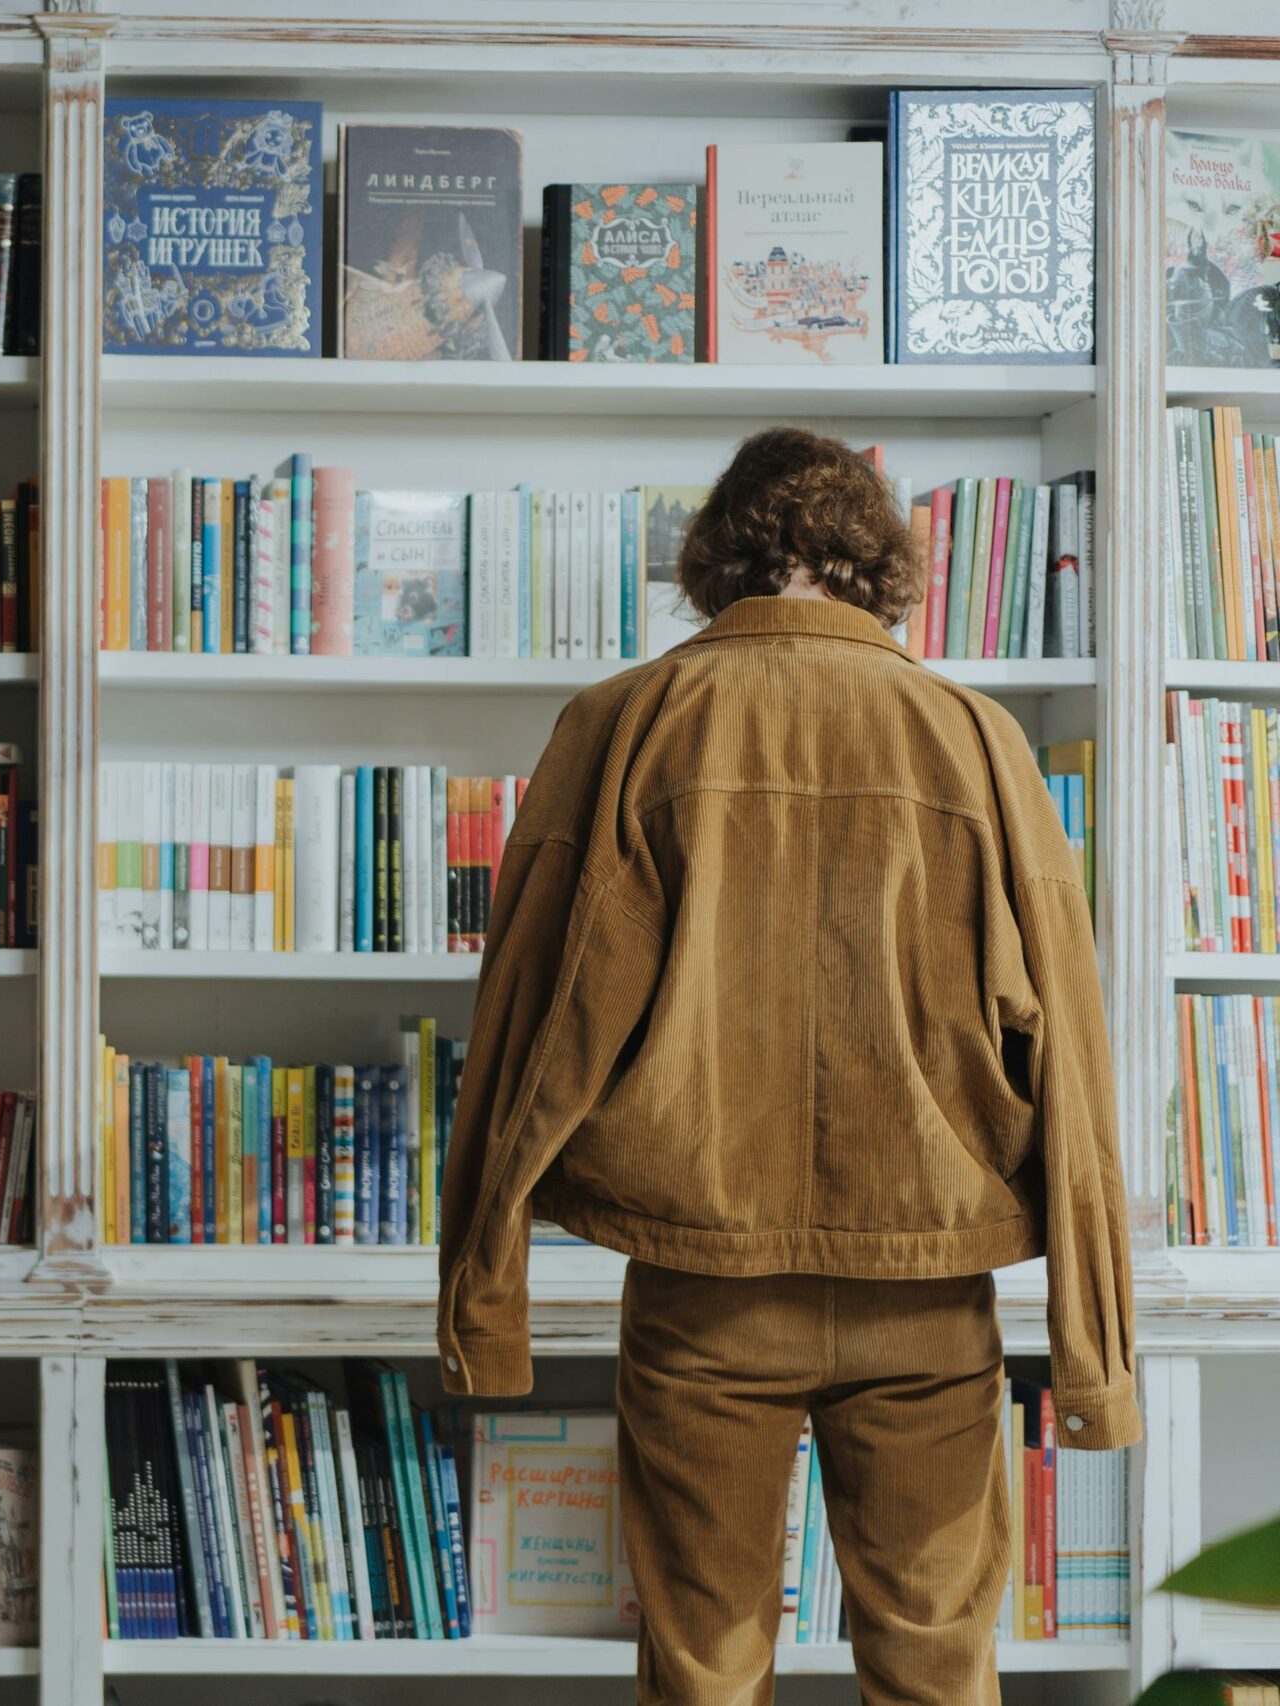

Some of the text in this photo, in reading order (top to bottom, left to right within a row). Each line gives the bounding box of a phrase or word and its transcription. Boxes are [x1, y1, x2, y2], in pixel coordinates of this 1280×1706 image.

[951, 152, 1050, 181] ВЕЛИКАЯ
[1190, 154, 1234, 174] Кольцо
[367, 173, 497, 191] ЛИНДБЕРГ
[737, 187, 855, 208] Нереальный
[951, 182, 1051, 220] КНИГА
[152, 207, 261, 236] ИСТОРИЯ
[770, 210, 822, 223] атлас
[604, 230, 662, 244] АЛИСА
[945, 218, 1051, 258] ЕДИНО
[149, 237, 264, 267] ИГРУШЕК
[951, 255, 1050, 296] РОГОВ
[3, 512, 14, 545] МОЭМ
[376, 519, 454, 537] СПАСИТЕЛЬ
[192, 541, 202, 586] МИНГЮ
[193, 588, 201, 607] ПАК
[517, 1488, 607, 1510] КАРТИНА
[520, 1535, 597, 1553] ЖЕНЩИНЫ
